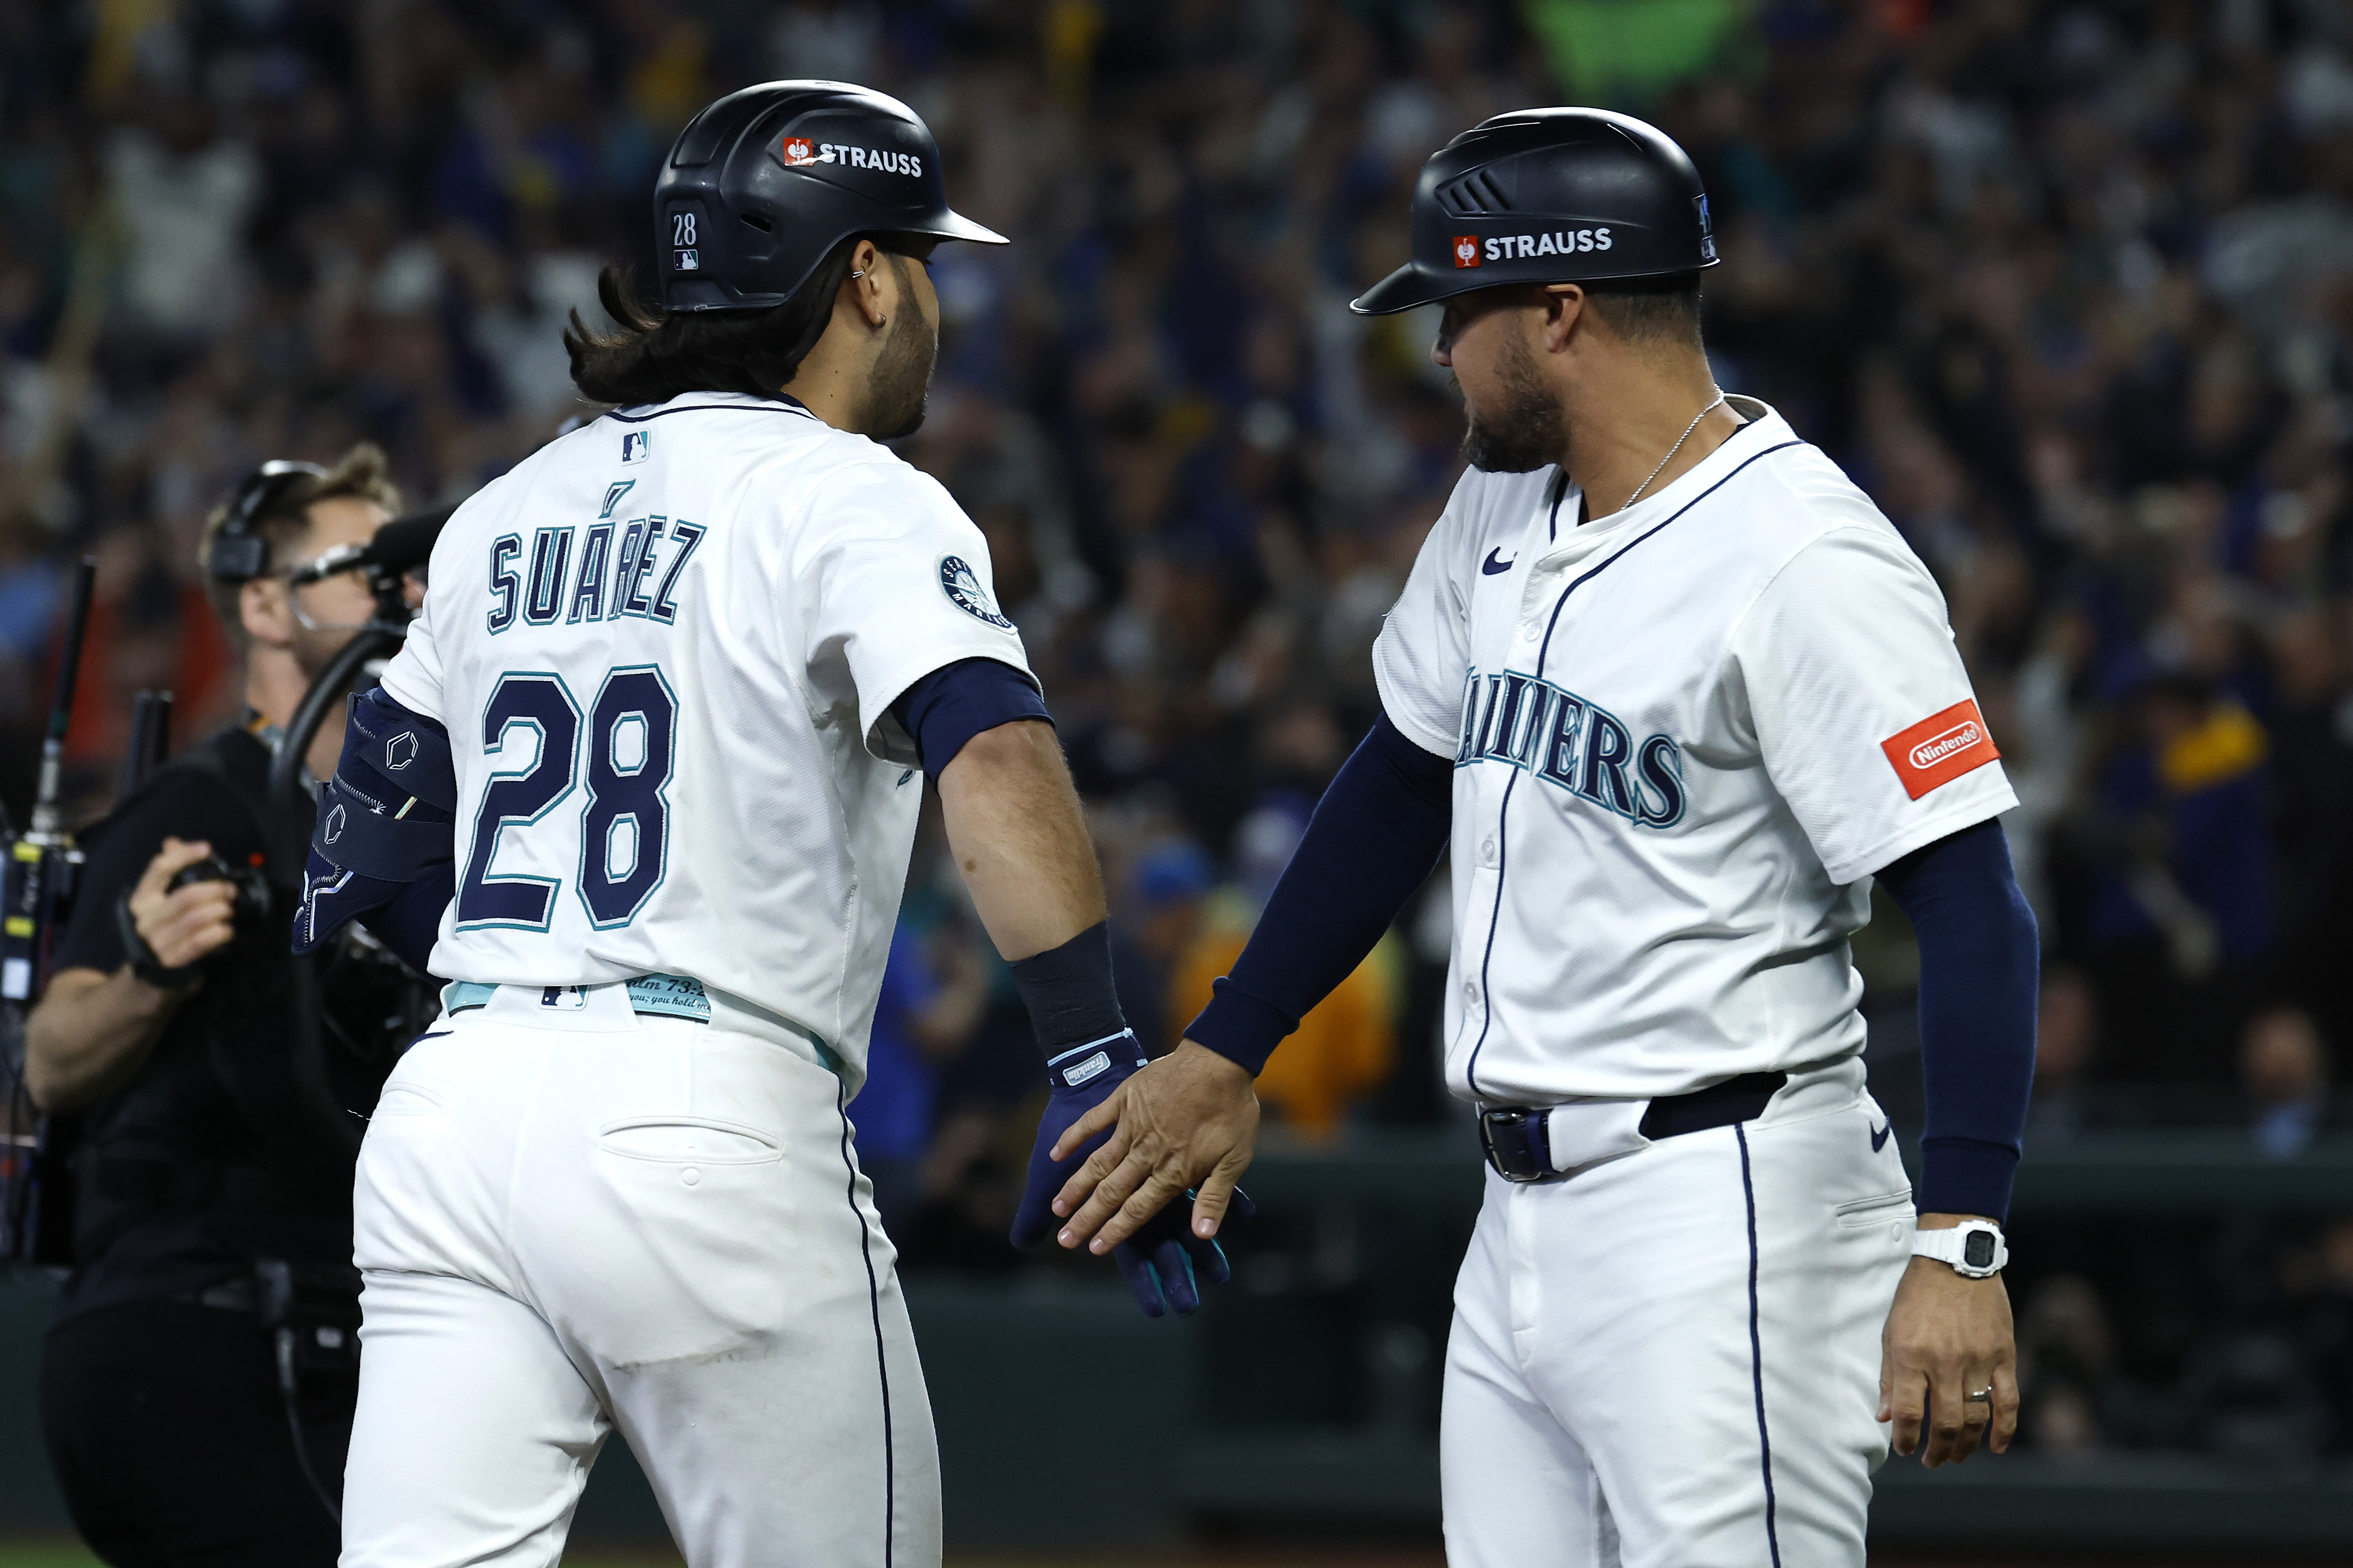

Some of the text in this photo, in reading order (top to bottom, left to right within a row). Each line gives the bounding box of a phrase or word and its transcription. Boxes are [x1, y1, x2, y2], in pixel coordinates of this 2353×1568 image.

[819, 143, 922, 178] STRAUSS
[673, 213, 697, 246] 28
[1485, 227, 1613, 261] STRAUSS
[487, 478, 708, 636] SUÁREZ
[1916, 727, 1978, 764] Nintendo
[455, 663, 680, 933] 28
[627, 976, 661, 990] alm
[651, 996, 670, 1005] you
[672, 996, 697, 1007] hold
[1067, 1054, 1105, 1081] Franklin
